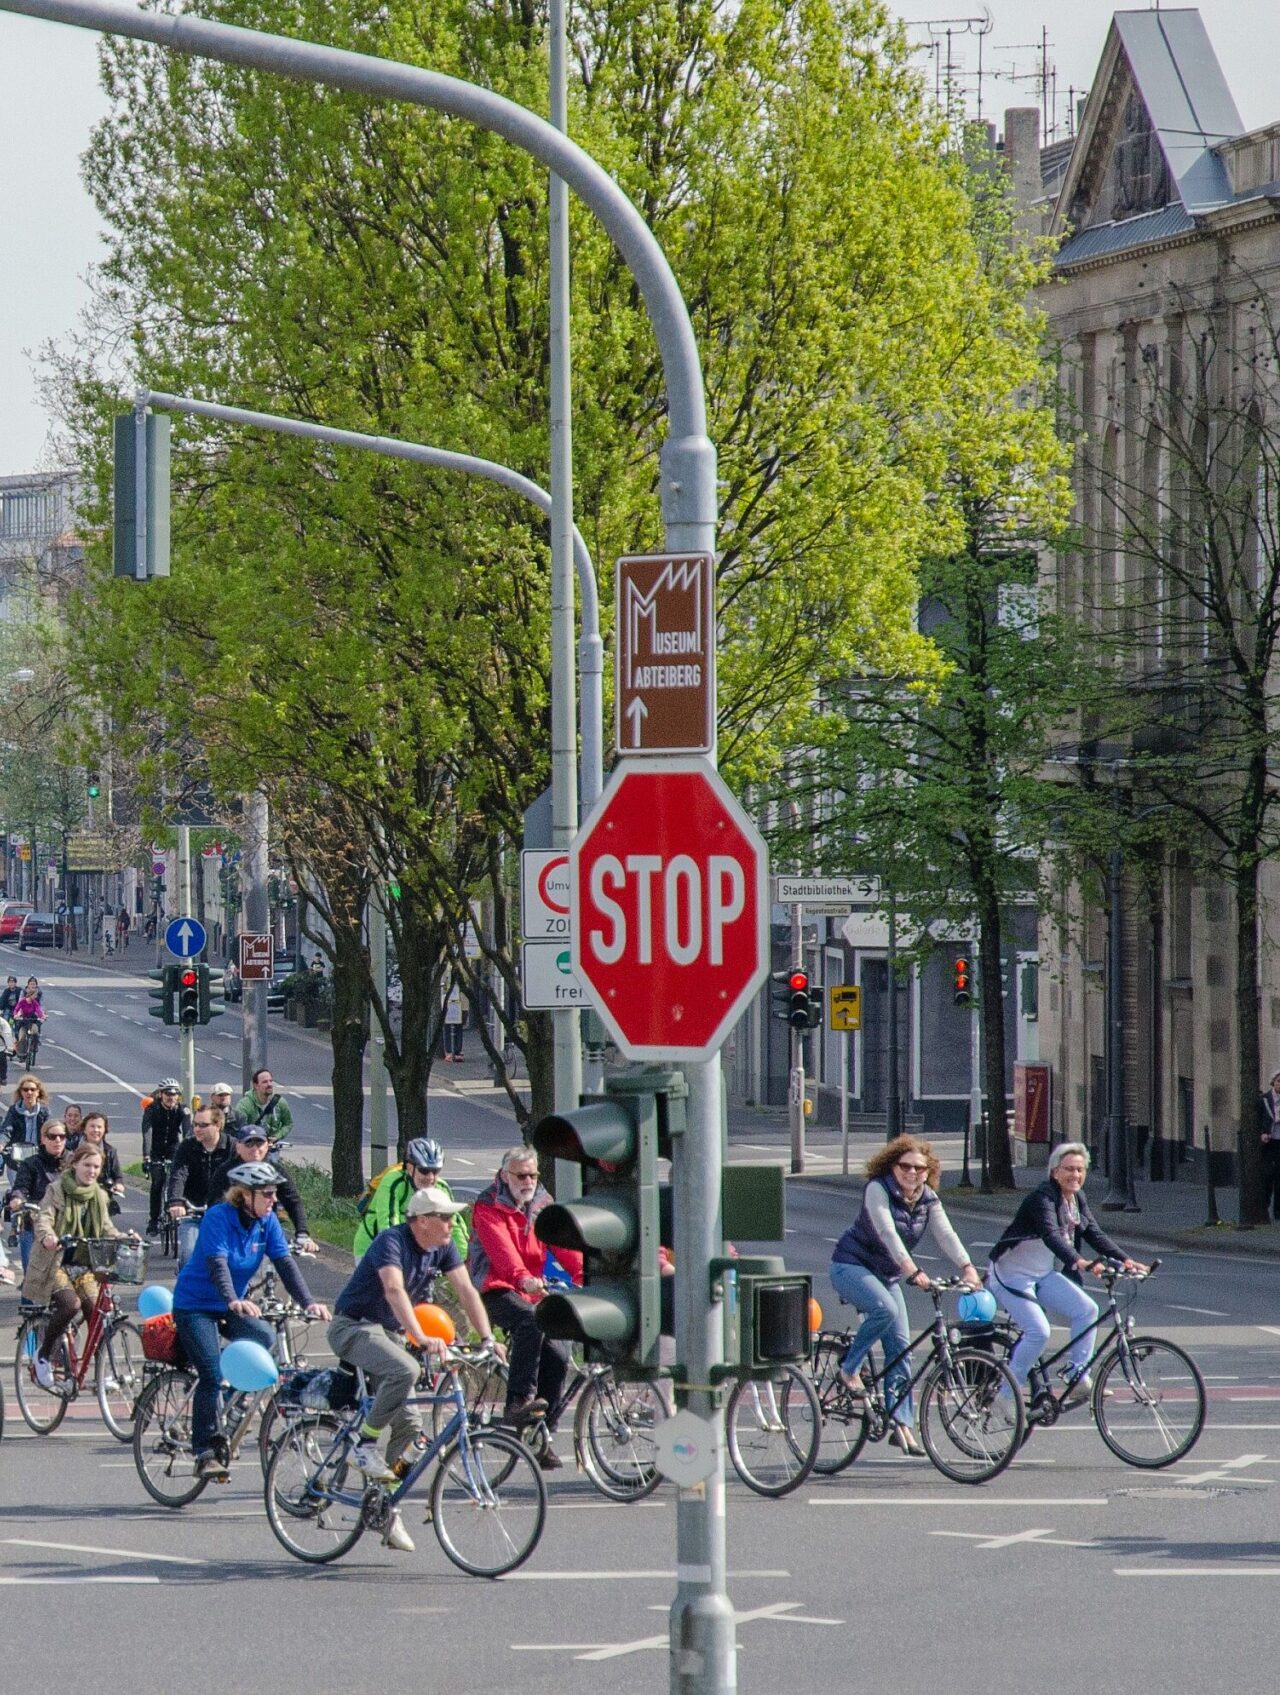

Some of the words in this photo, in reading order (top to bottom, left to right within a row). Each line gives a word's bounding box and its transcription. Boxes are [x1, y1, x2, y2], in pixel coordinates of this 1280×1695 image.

[634, 600, 700, 654] MUSEUM
[635, 665, 701, 688] ABTEIBERG
[783, 884, 852, 896] Stadtbibliothek
[590, 854, 746, 966] STOP
[546, 919, 571, 933] ZO
[555, 985, 583, 998] frei
